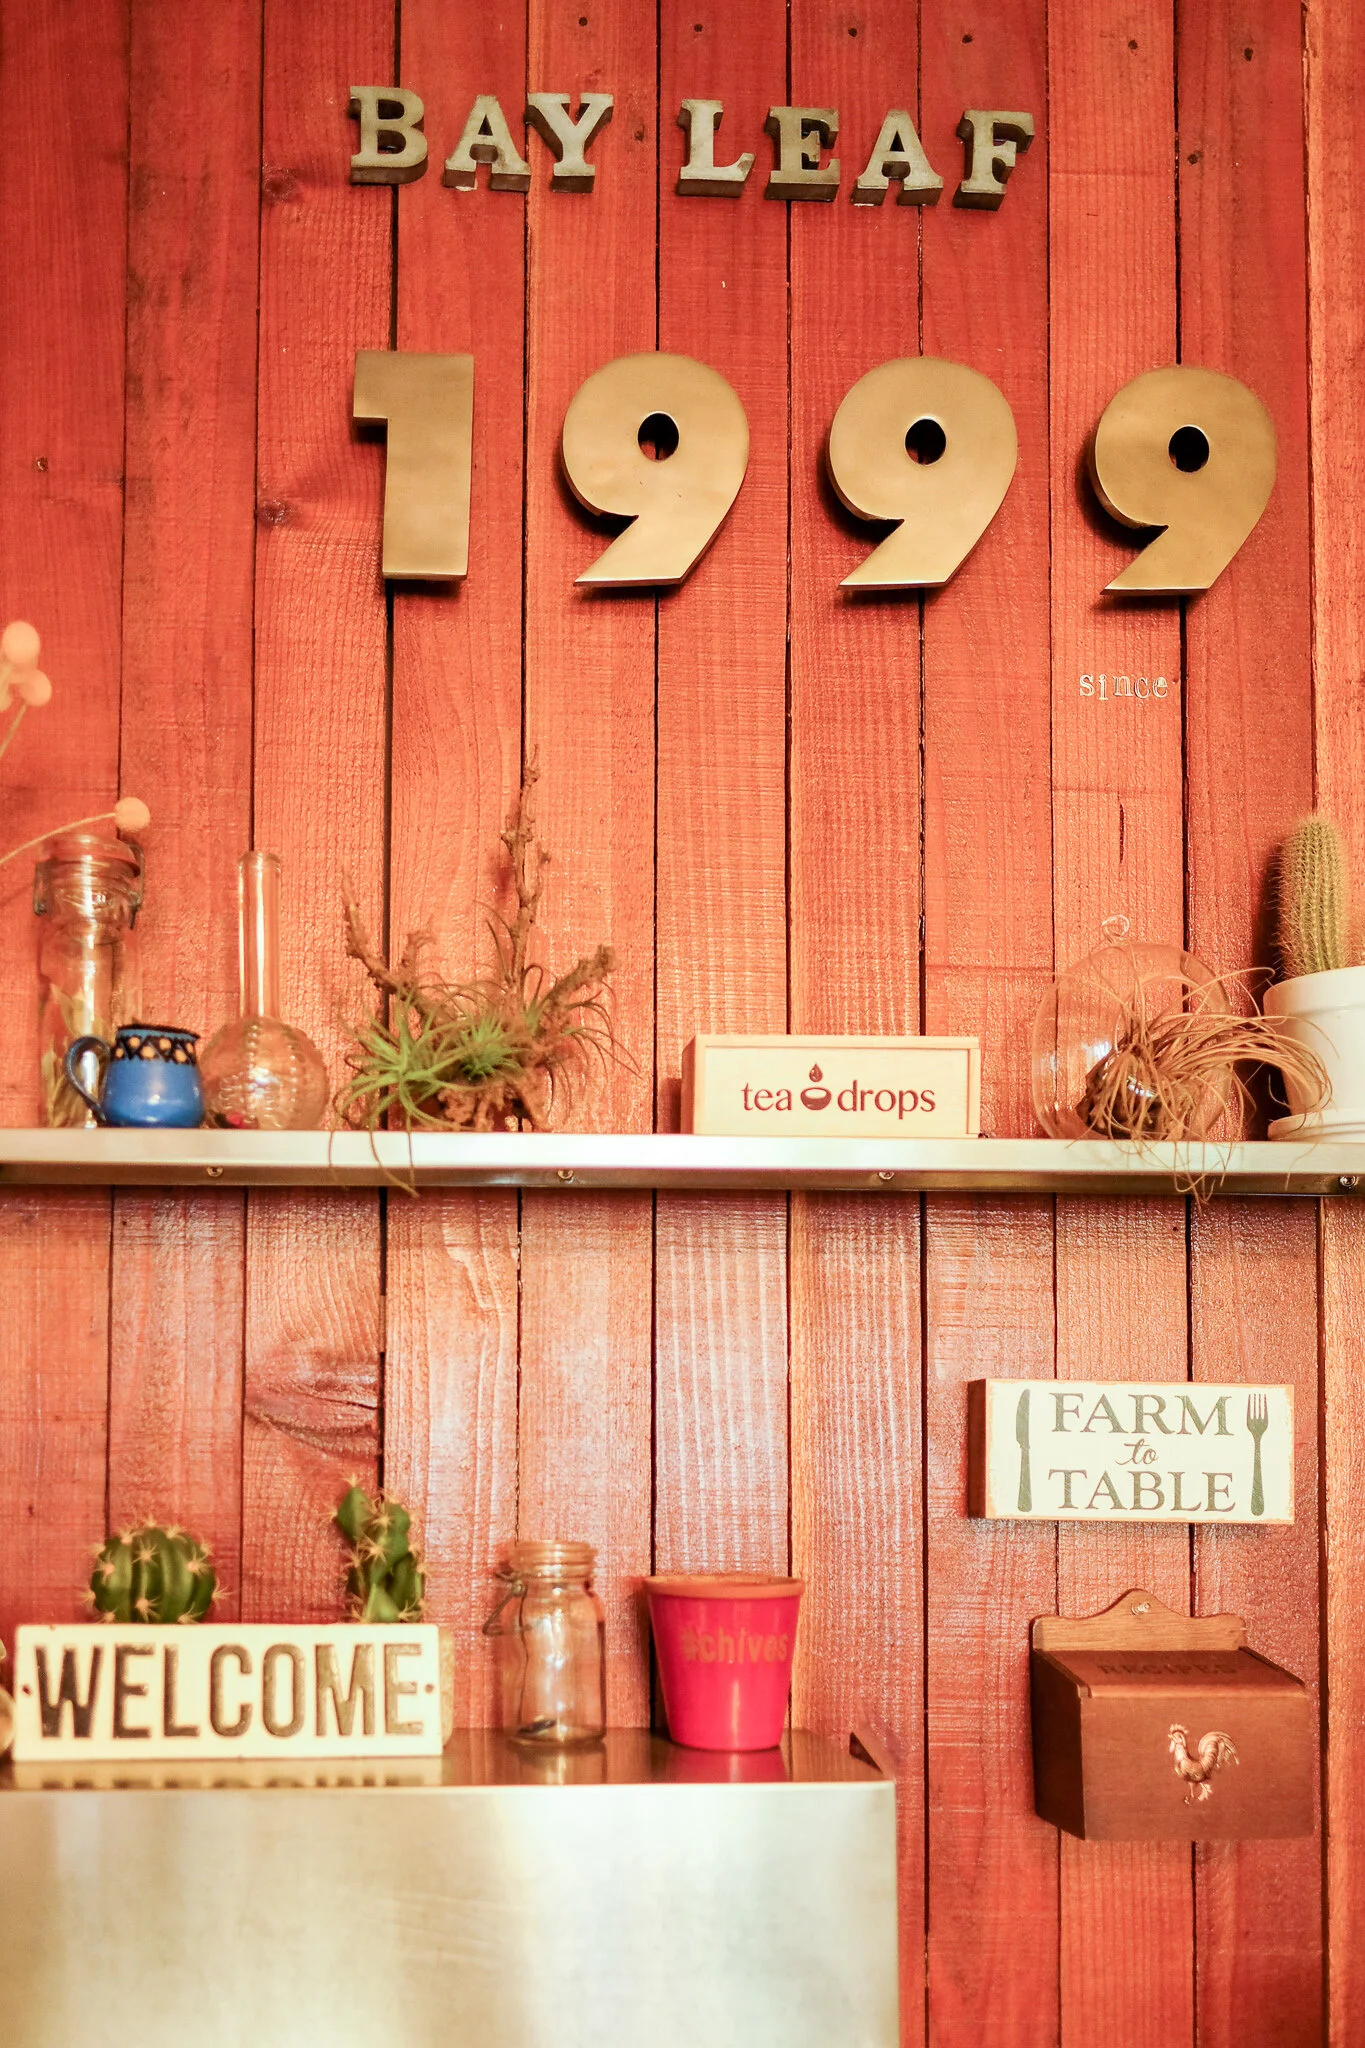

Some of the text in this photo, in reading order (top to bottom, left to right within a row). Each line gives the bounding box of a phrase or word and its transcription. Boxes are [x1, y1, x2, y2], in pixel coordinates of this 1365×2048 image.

[350, 86, 1033, 209] BAY LEAF
[353, 350, 1277, 596] 1999
[1079, 674, 1168, 700] since
[740, 1080, 936, 1119] tea drops
[1049, 1392, 1234, 1435] FARM
[1115, 1438, 1158, 1465] to
[1048, 1469, 1236, 1512] TABLE
[34, 1643, 424, 1739] WELCOME
